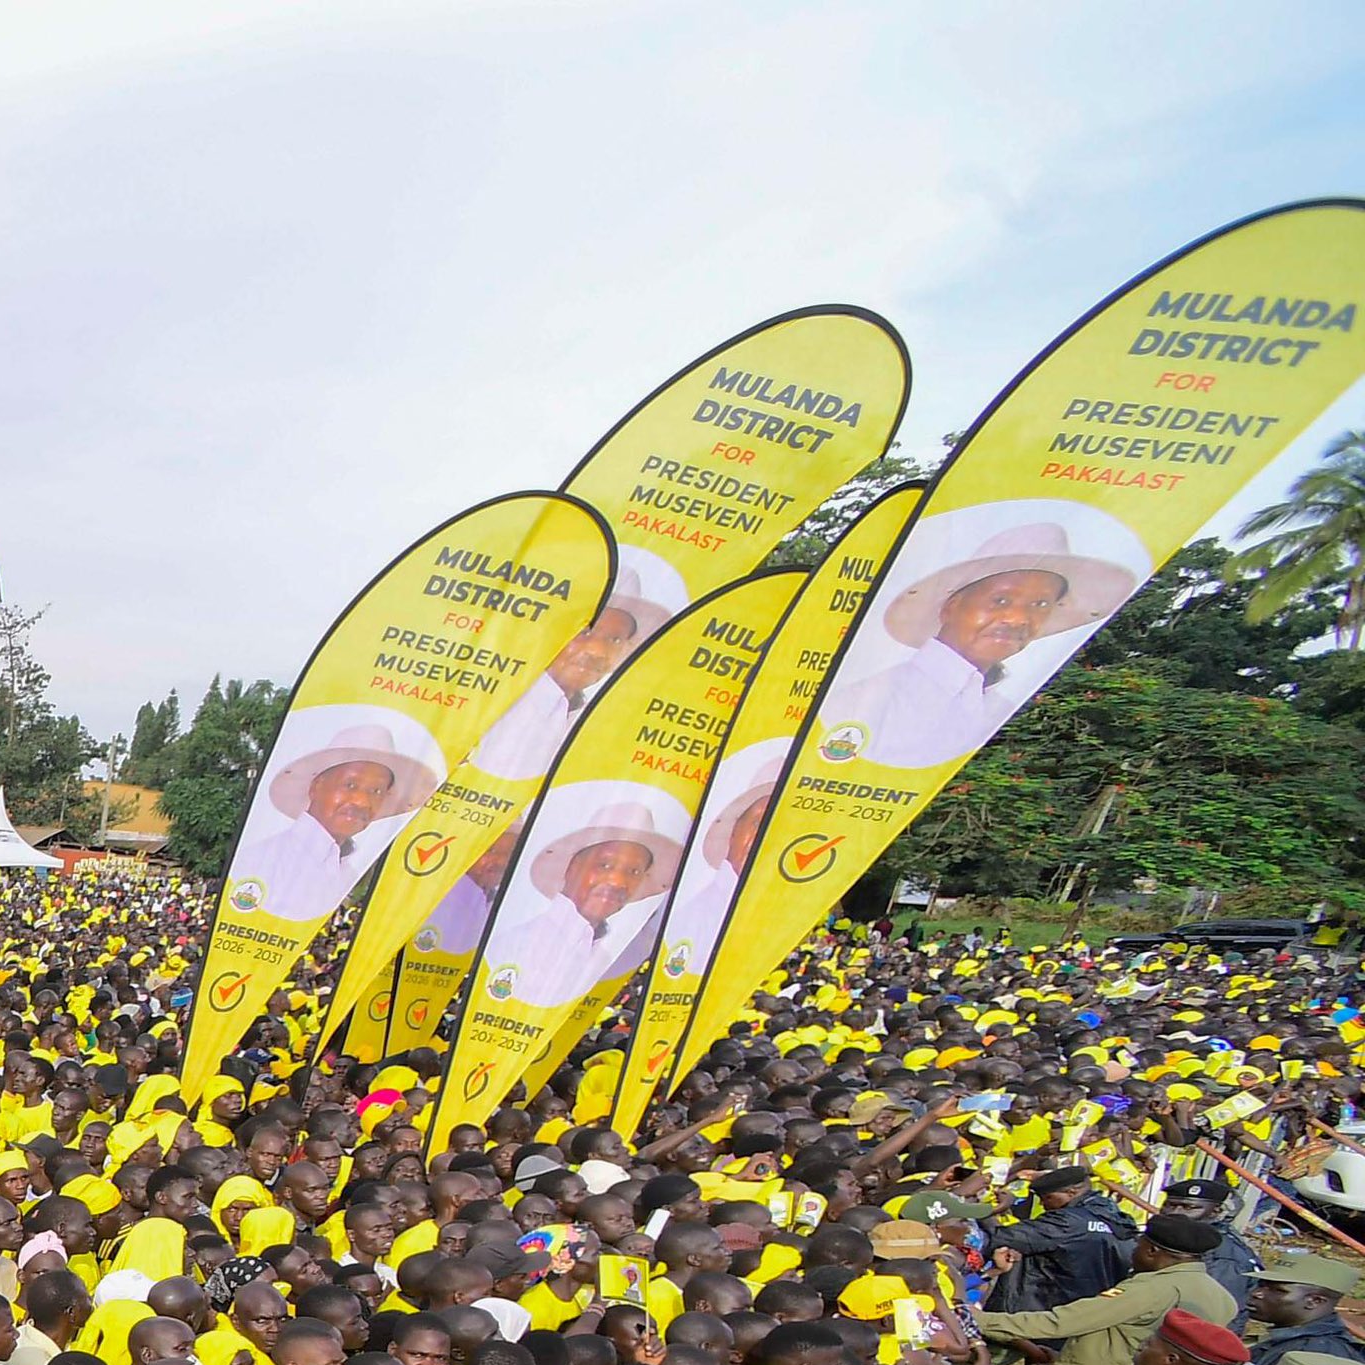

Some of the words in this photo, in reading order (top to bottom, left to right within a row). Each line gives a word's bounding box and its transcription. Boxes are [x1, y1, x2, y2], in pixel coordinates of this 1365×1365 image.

[1146, 290, 1358, 333] MULANDA
[1128, 328, 1320, 367] DISTRICT
[708, 367, 862, 428] MULANDA
[1154, 372, 1216, 394] FOR
[692, 399, 834, 453] DISTRICT
[1061, 398, 1279, 439] PRESIDENT
[711, 441, 756, 466] FOR
[1047, 432, 1236, 465] MUSEVENI
[640, 455, 795, 515] PRESIDENT
[1039, 462, 1184, 491] PAKALAST
[629, 484, 764, 535] MUSEVENI
[621, 510, 726, 553] PAKALAST
[434, 546, 571, 601] MULANDA
[423, 575, 550, 622] DISTRICT
[829, 589, 867, 614] DIST
[443, 612, 485, 634] FOR
[702, 617, 767, 655] MULA
[381, 625, 527, 677] PRESIDENT
[688, 647, 753, 685] DIST
[373, 653, 500, 695] MUSEVENI
[369, 675, 469, 711] PAKALAST
[645, 698, 729, 738] PRESID
[635, 725, 719, 761] MUSEV
[631, 750, 712, 785] PAKALAS
[436, 782, 515, 814] ESIDENT
[796, 775, 918, 806] PRESIDENT
[423, 796, 450, 814] 026
[460, 808, 495, 828] 2031
[791, 795, 834, 813] 2026
[849, 805, 893, 823] 2031
[213, 937, 245, 955] 2026
[252, 947, 283, 965] 2031
[217, 921, 300, 952] PRESIDENT
[472, 1010, 545, 1041] PREIDENT
[498, 1036, 529, 1054] 2031
